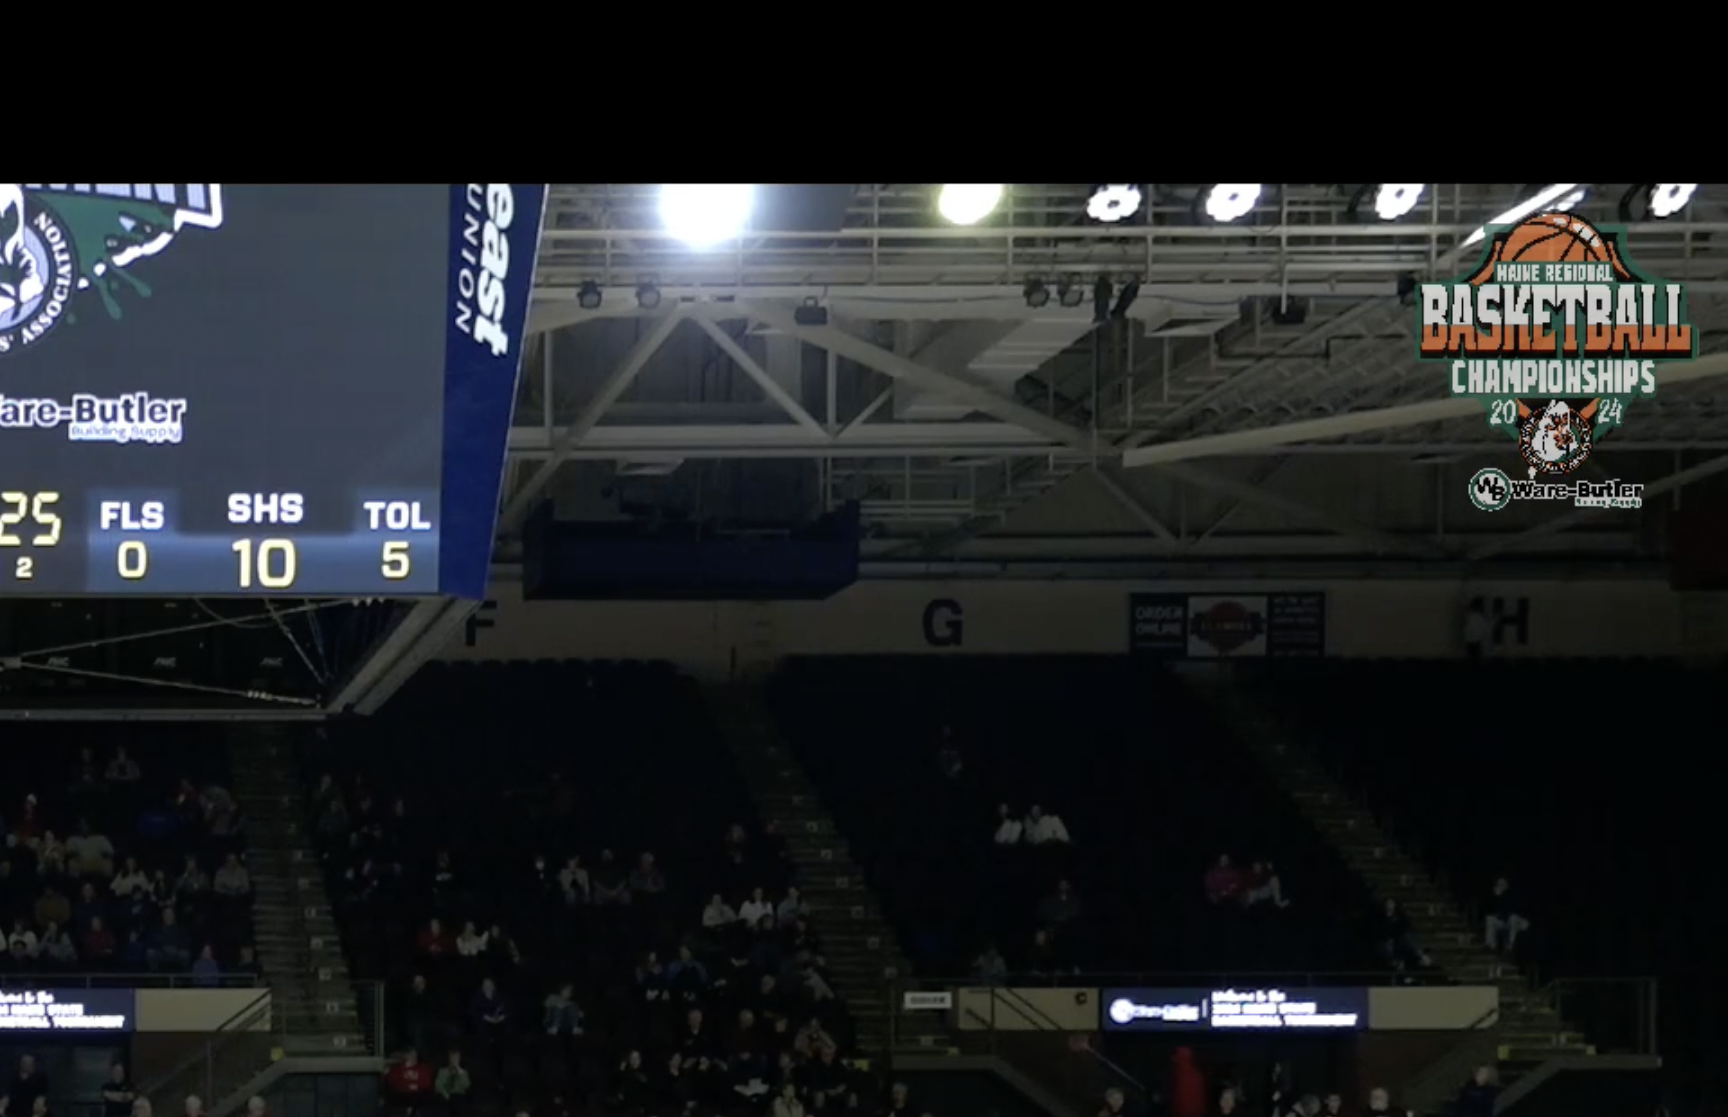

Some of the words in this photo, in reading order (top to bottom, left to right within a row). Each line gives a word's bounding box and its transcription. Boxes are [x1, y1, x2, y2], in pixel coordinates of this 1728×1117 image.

[455, 184, 483, 333] UNION
[22, 212, 72, 344] ASSOCIATION
[100, 501, 165, 530] FLS
[227, 493, 304, 524] SHS
[364, 501, 431, 530] TOL
[15, 556, 33, 578] 2
[117, 540, 147, 578] 0
[231, 538, 297, 588] 10
[381, 541, 410, 578] 5
[921, 599, 963, 647] G
